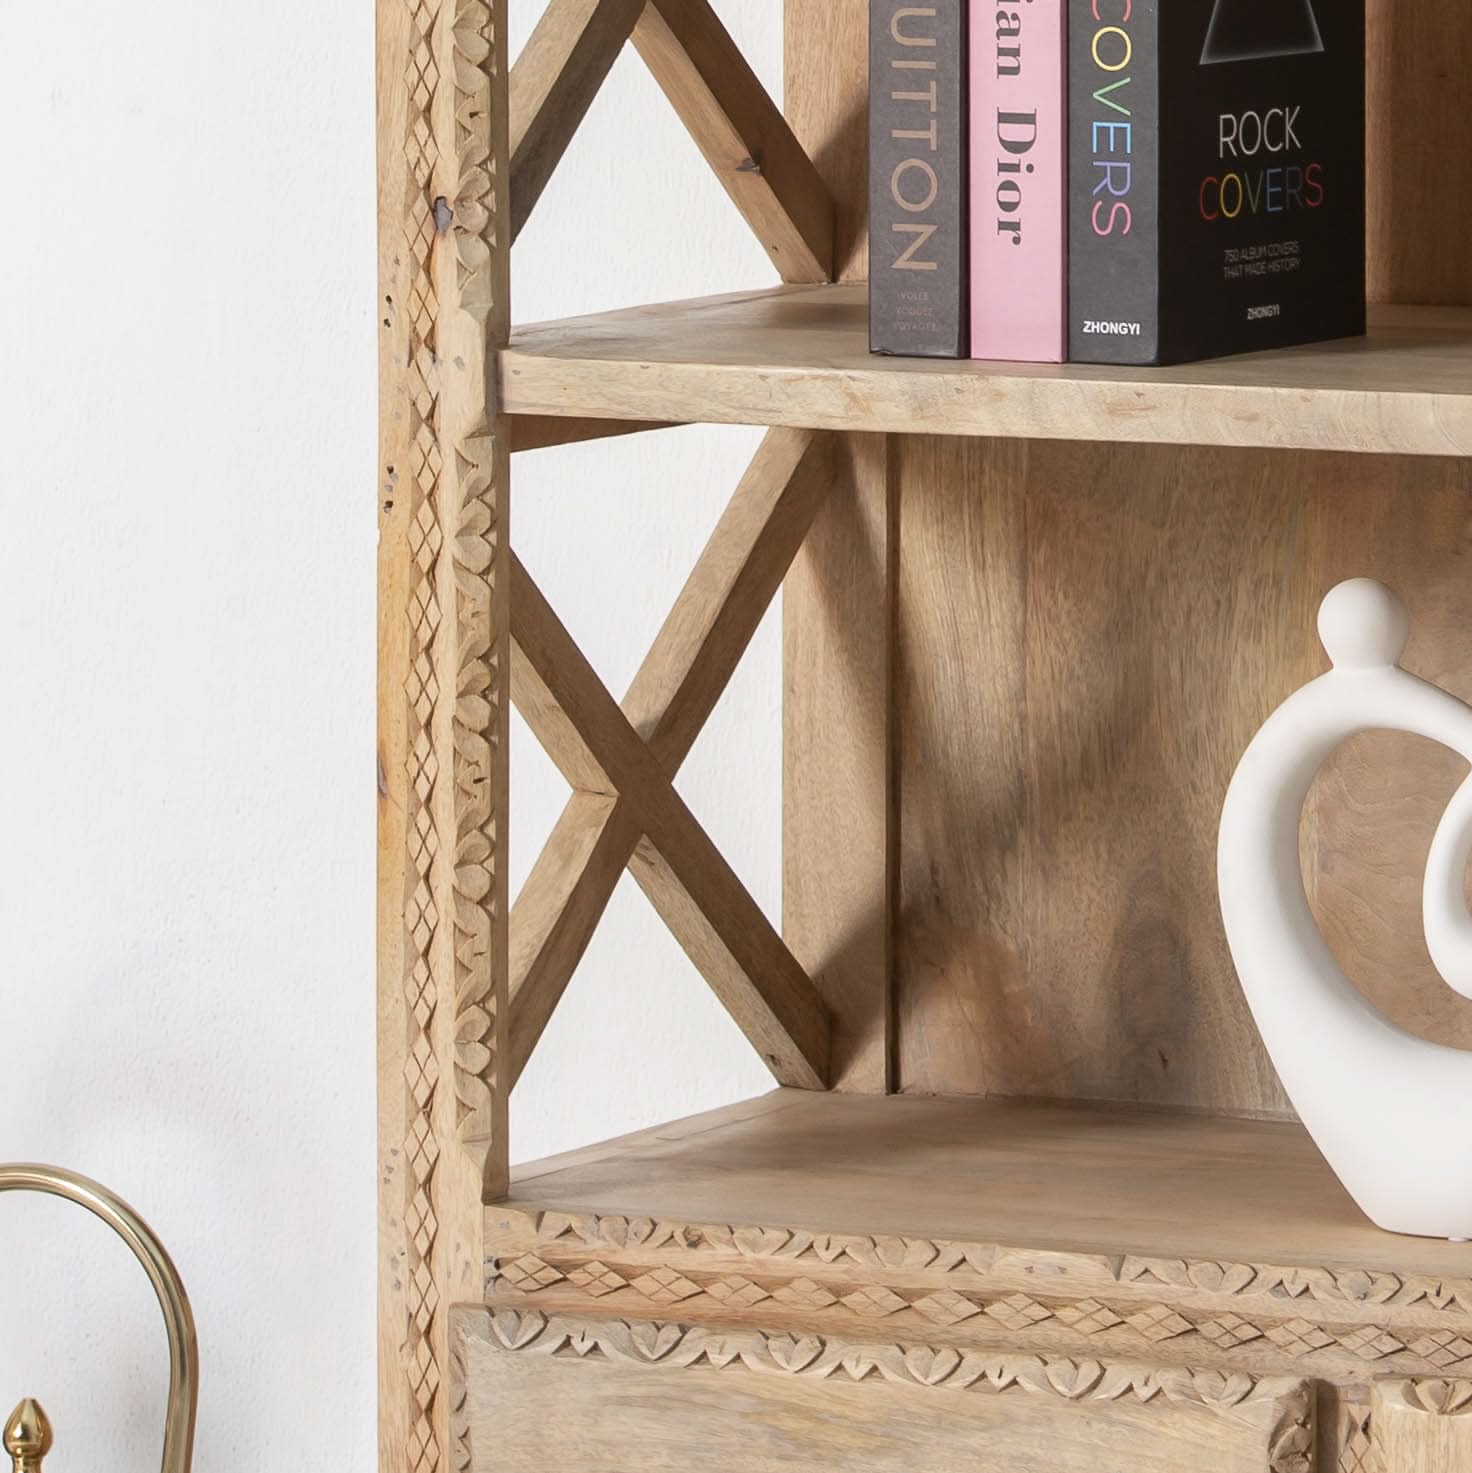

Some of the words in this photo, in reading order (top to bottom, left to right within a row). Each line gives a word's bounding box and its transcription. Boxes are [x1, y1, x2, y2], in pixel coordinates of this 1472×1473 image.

[1219, 105, 1302, 159] ROCK
[996, 107, 1037, 246] Dior
[1199, 163, 1324, 221] COVERS
[1083, 321, 1141, 335] ZHONGYI
[1247, 304, 1280, 320] ZHONGYI
